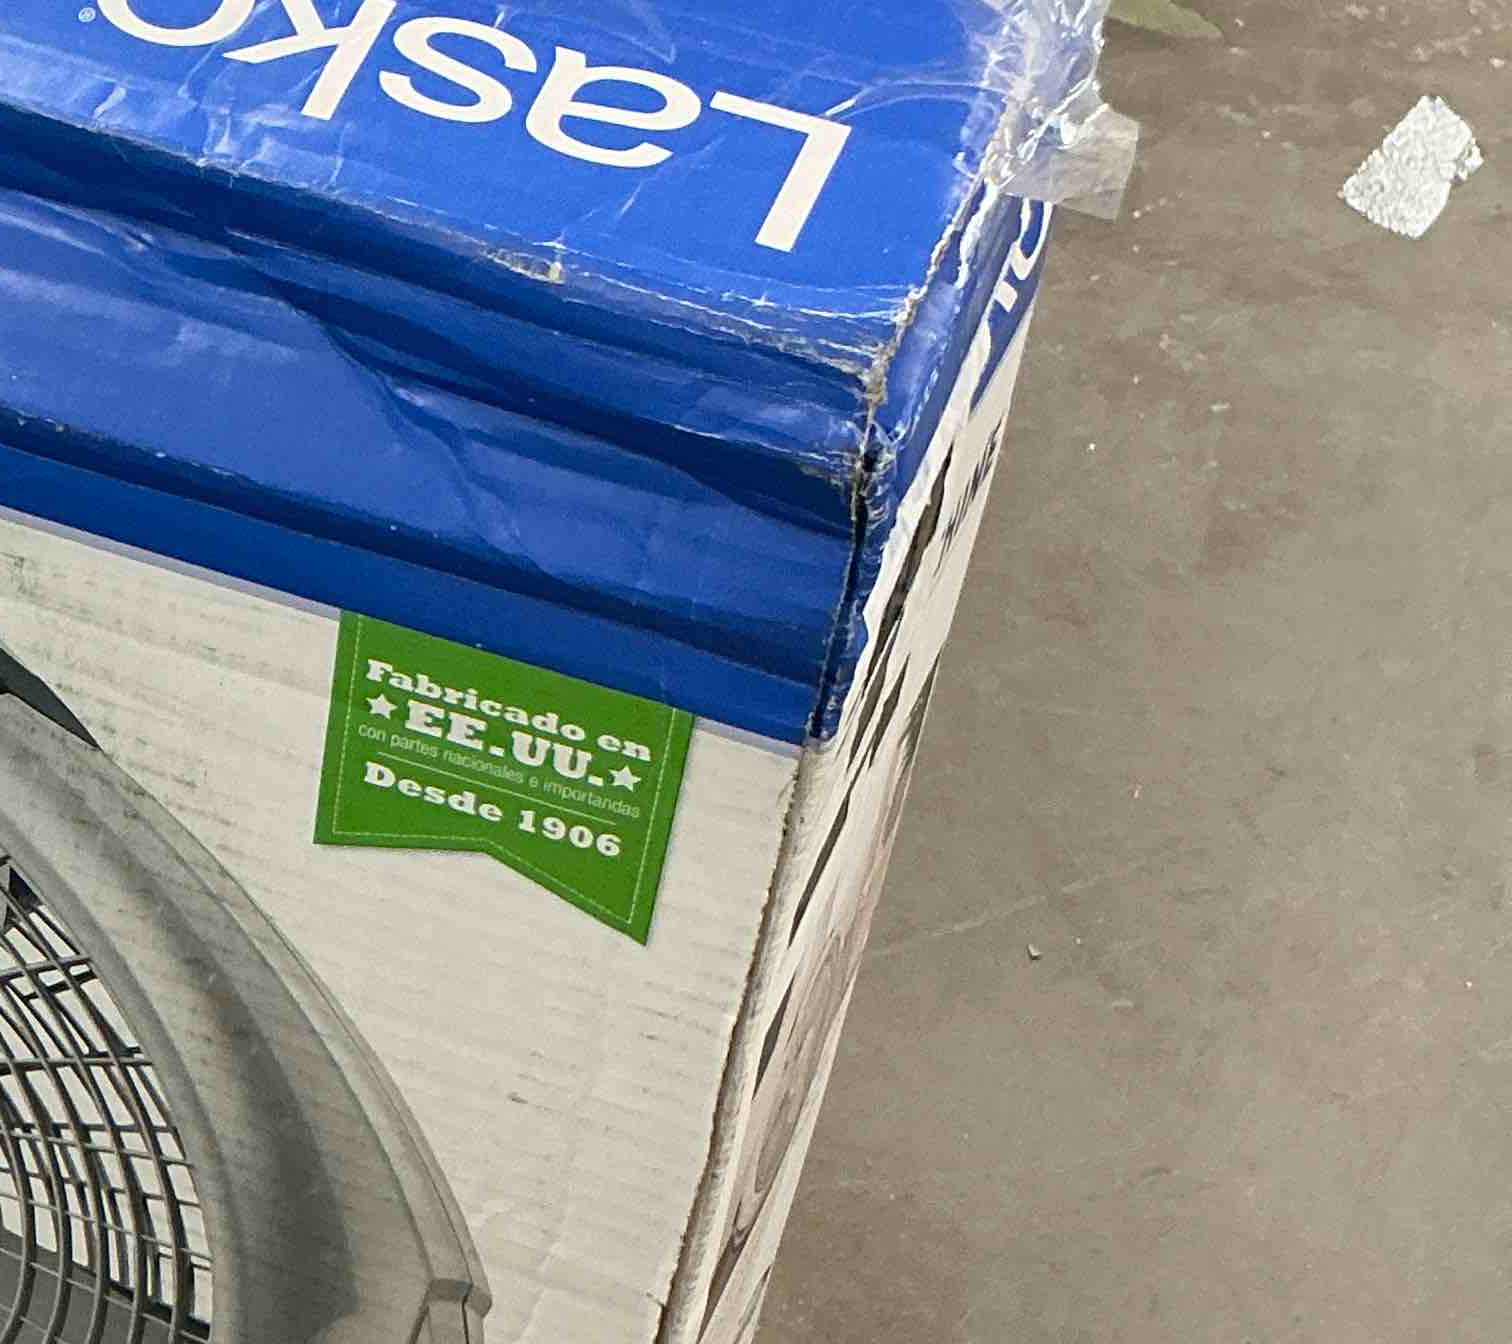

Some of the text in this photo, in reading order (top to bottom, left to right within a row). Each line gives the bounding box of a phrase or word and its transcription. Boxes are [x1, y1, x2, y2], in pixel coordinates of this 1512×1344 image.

[357, 722, 387, 742] con
[389, 731, 439, 759] partes
[442, 747, 525, 785] nacionales
[365, 658, 651, 762] Fabricado en
[404, 699, 605, 787] EE.UU.
[363, 760, 623, 857] Desde 1906
